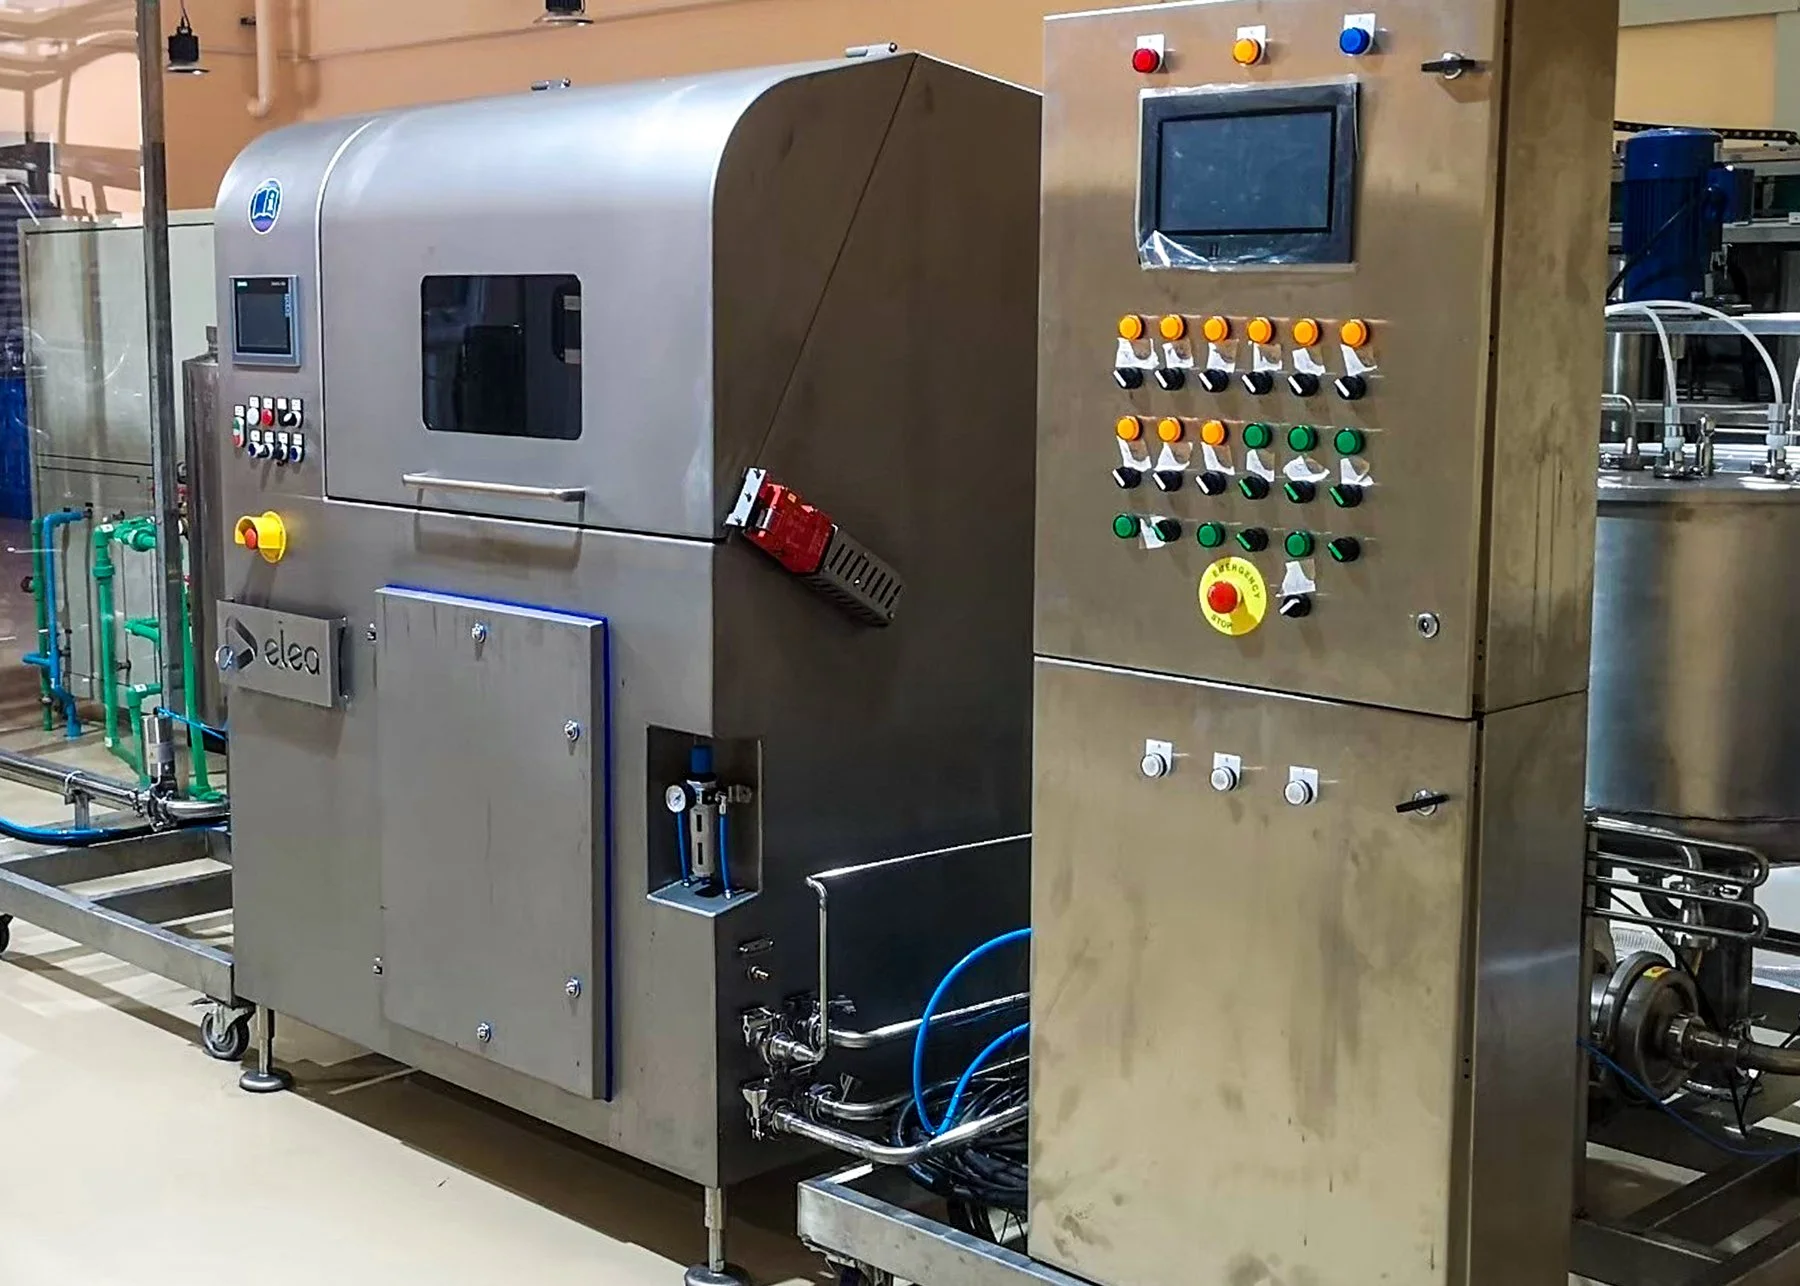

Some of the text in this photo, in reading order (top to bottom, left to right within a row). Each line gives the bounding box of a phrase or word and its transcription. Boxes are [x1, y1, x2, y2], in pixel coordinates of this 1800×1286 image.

[1212, 562, 1261, 599] EMERGENCY
[1211, 614, 1233, 629] STOP
[264, 627, 320, 675] elea
